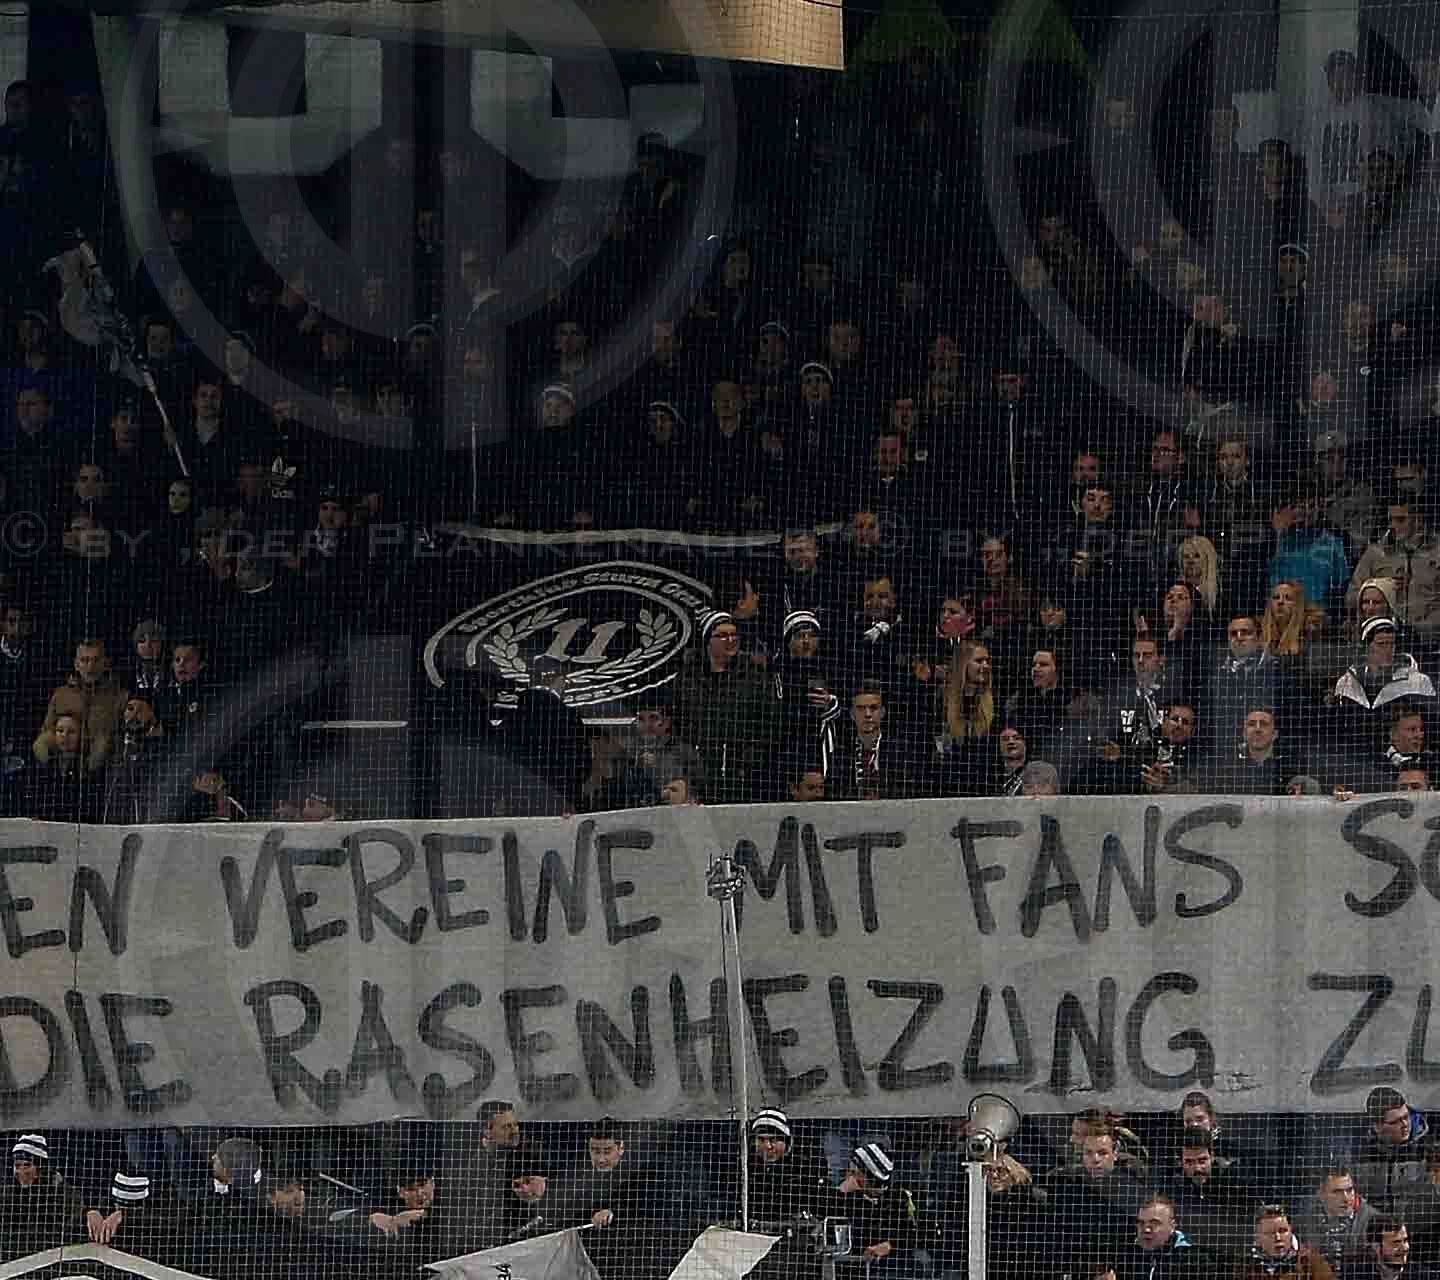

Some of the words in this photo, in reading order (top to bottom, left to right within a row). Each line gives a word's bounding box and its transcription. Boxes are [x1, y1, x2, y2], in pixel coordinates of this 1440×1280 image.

[220, 817, 661, 952] VEREINE
[734, 820, 907, 939] MIT
[952, 803, 1245, 939] FANS
[242, 968, 1221, 1112] RASENHEIZUNG
